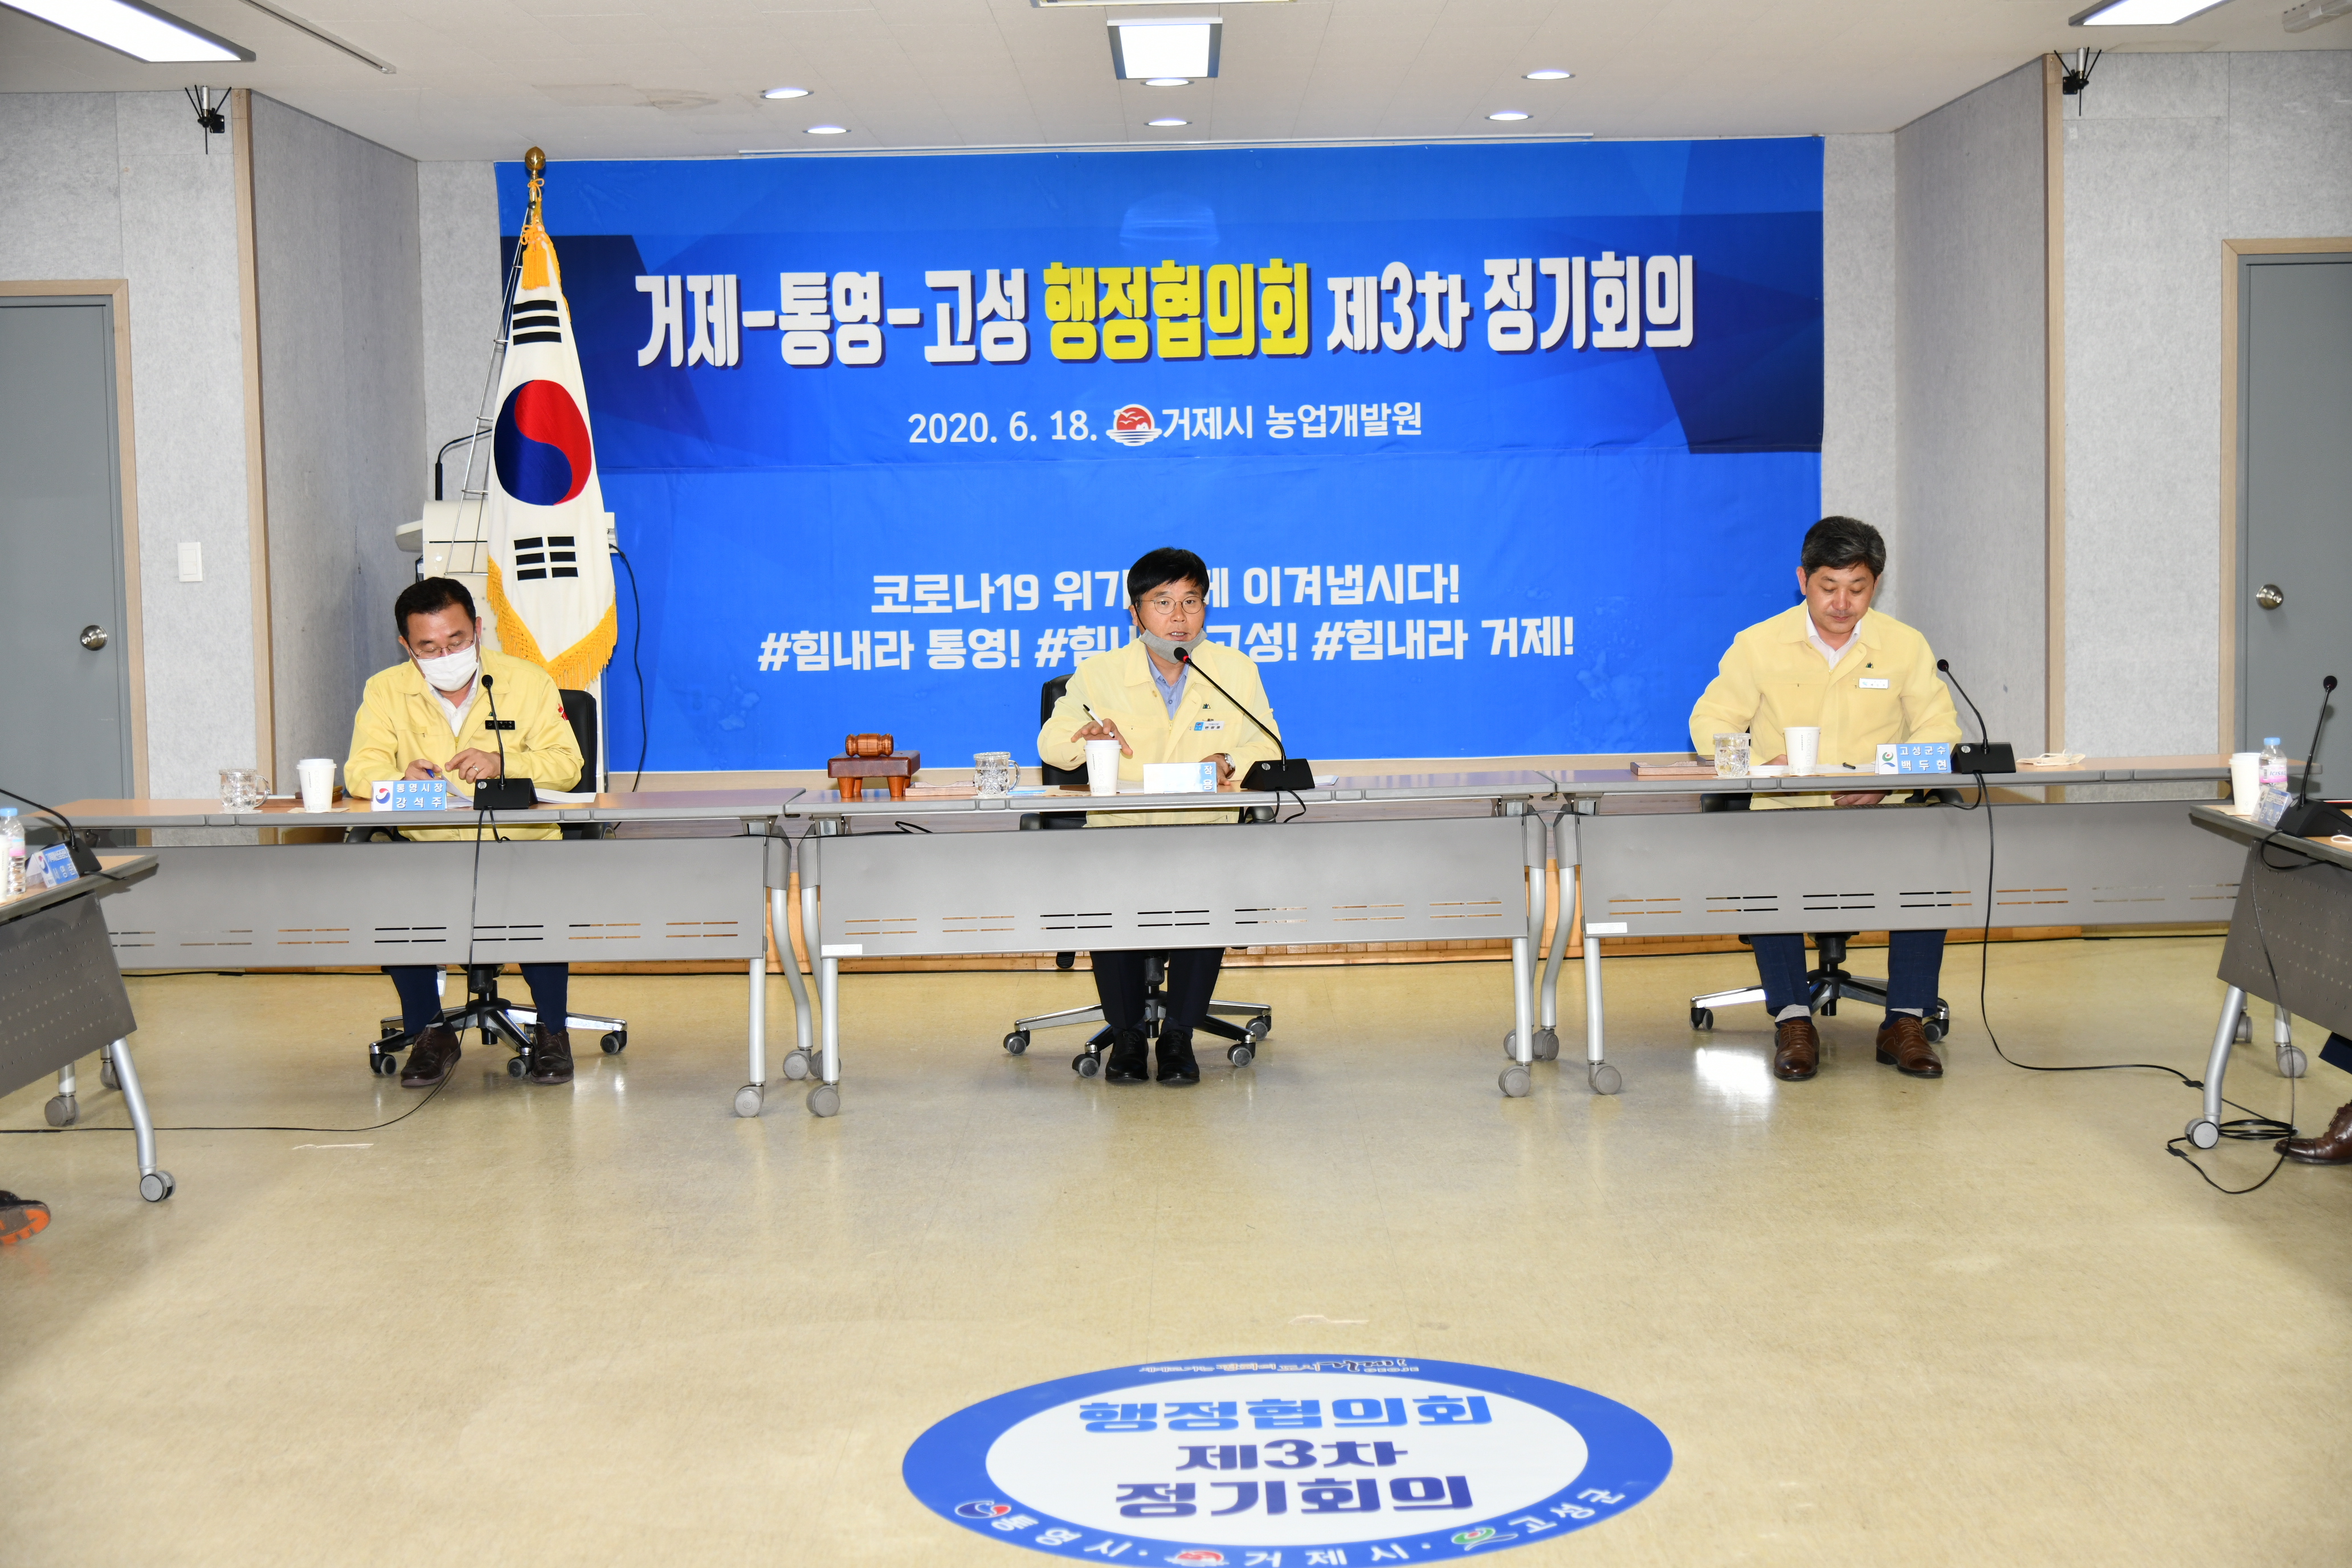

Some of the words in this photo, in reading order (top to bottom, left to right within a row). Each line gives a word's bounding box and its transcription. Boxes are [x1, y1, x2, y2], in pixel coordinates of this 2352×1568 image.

[635, 268, 1026, 368] 거제-통영-고성
[1043, 258, 1308, 360] 행정협의회
[1327, 261, 1469, 352] 제3차
[1484, 251, 1693, 350] 정기회의
[908, 413, 995, 444] 2020.
[1009, 411, 1036, 442] 6.
[1051, 410, 1097, 442] 18.
[1161, 405, 1253, 440] 거제시
[1265, 402, 1422, 438] 농업개발원
[871, 573, 1039, 614] 코로나19
[1243, 564, 1460, 607] 이겨냅시다!
[758, 630, 914, 671] #힘내라
[926, 628, 1020, 669] 통영!
[1206, 622, 1297, 663] 고성!
[1312, 619, 1468, 661] #힘내라
[1481, 616, 1574, 657] 거제!
[1900, 746, 1946, 756] 고성군수
[1901, 760, 1947, 772] 백두현
[396, 797, 443, 809] 강석주
[397, 783, 443, 793] 통영시장
[1079, 1395, 1492, 1434] 행정협의회
[1175, 1438, 1408, 1471] 제3차
[1116, 1475, 1473, 1519] 정기회의
[1244, 1543, 1409, 1568] 거제시
[1508, 1487, 1626, 1534] 고성군
